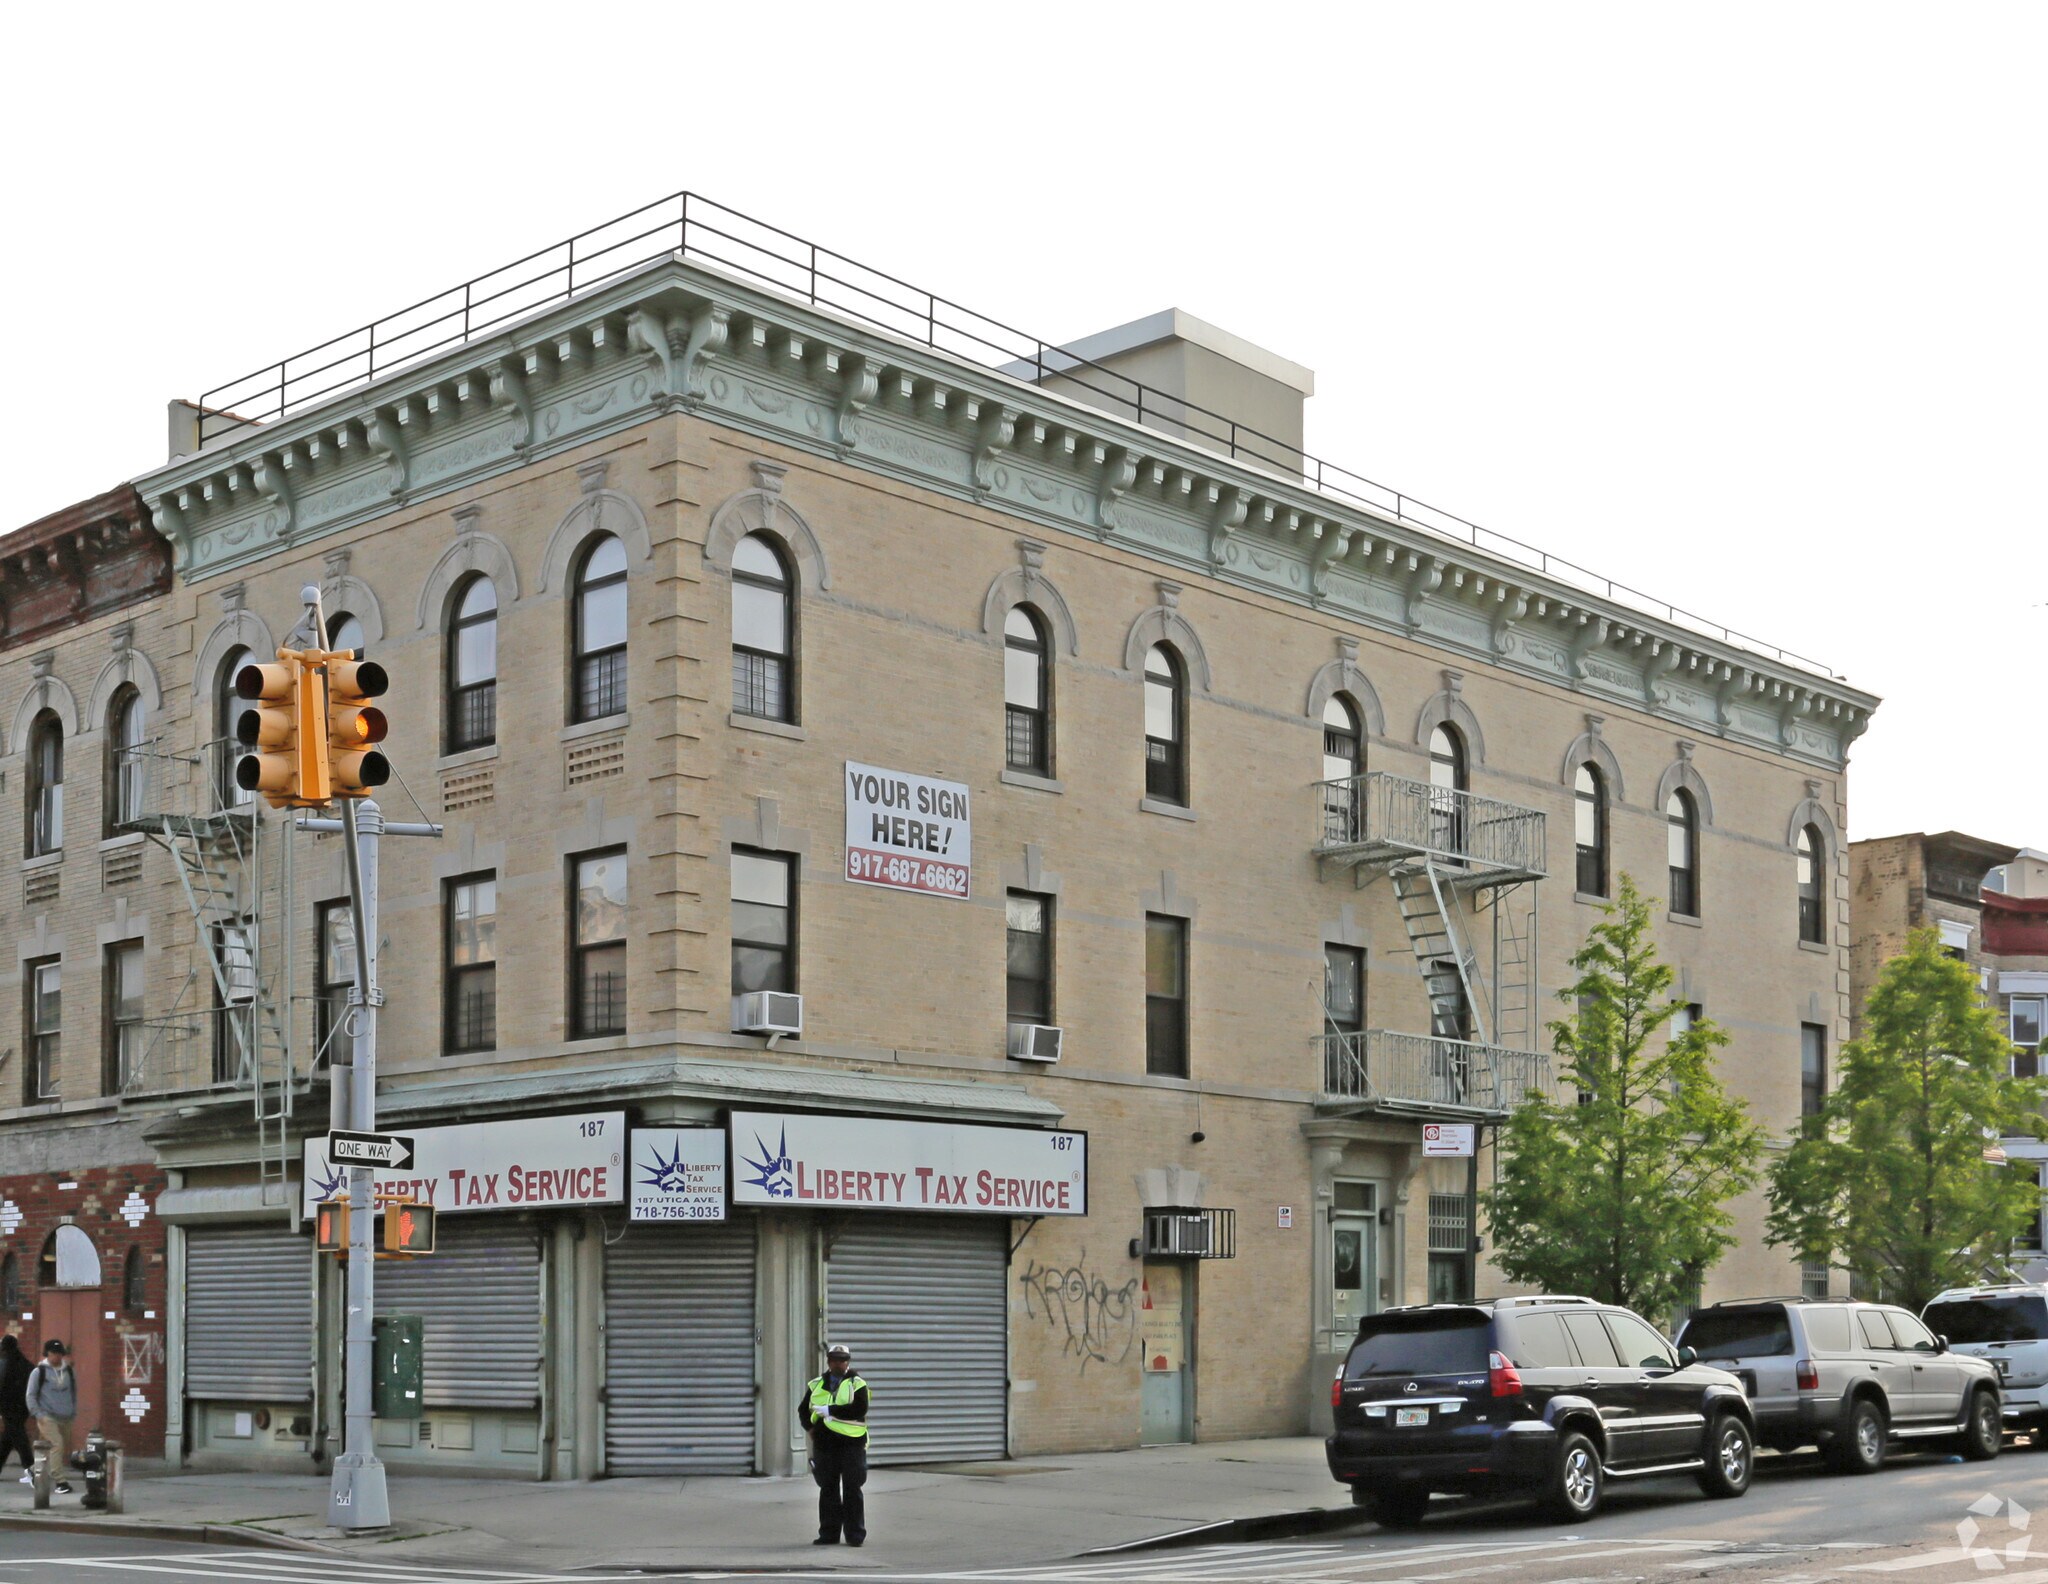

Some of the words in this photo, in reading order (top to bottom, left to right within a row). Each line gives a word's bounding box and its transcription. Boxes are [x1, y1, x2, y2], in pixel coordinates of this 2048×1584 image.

[850, 772, 910, 810] YOUR
[917, 785, 967, 821] SIGN
[872, 813, 952, 855] HERE!
[850, 851, 967, 892] 917-687-6662
[579, 1120, 604, 1138] 187
[339, 1142, 361, 1156] ONE
[368, 1144, 392, 1158] WAY
[1050, 1136, 1073, 1150] 187
[686, 1164, 722, 1172] LIBERTY
[686, 1174, 704, 1182] TAX
[797, 1161, 906, 1201] LIBERTY
[915, 1167, 968, 1205] TAX
[976, 1169, 1070, 1209] SERVICE
[374, 1178, 438, 1210] BERTY
[448, 1168, 500, 1206] TAX
[507, 1164, 607, 1203] SERVICE
[686, 1185, 723, 1193] SERVICE
[635, 1206, 720, 1218] 718-756-3035
